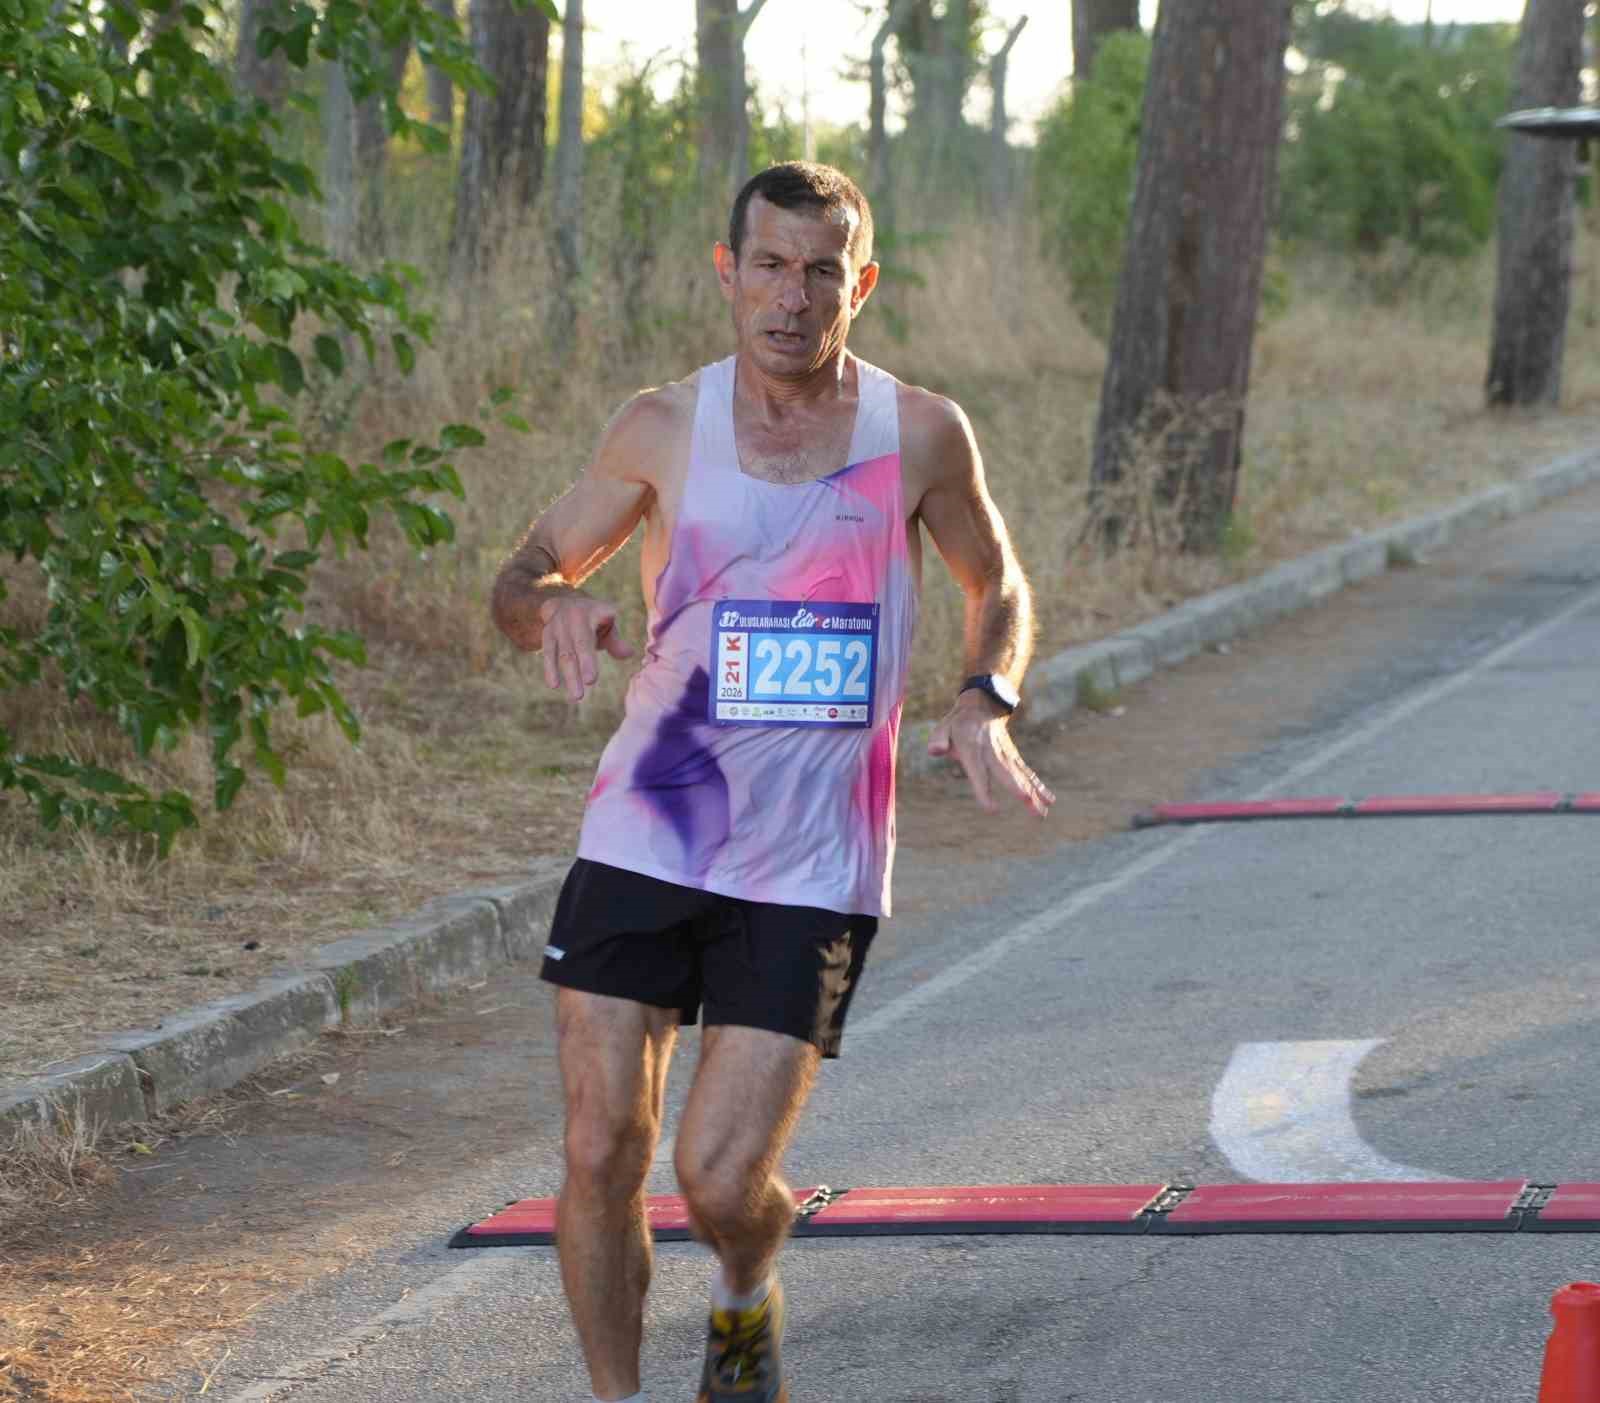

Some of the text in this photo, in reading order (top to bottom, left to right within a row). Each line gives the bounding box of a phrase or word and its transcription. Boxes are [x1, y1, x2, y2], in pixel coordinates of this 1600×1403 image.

[831, 616, 872, 630] Maratonu
[725, 635, 741, 684] 21 K
[754, 639, 867, 696] 2252
[721, 688, 743, 697] 2026
